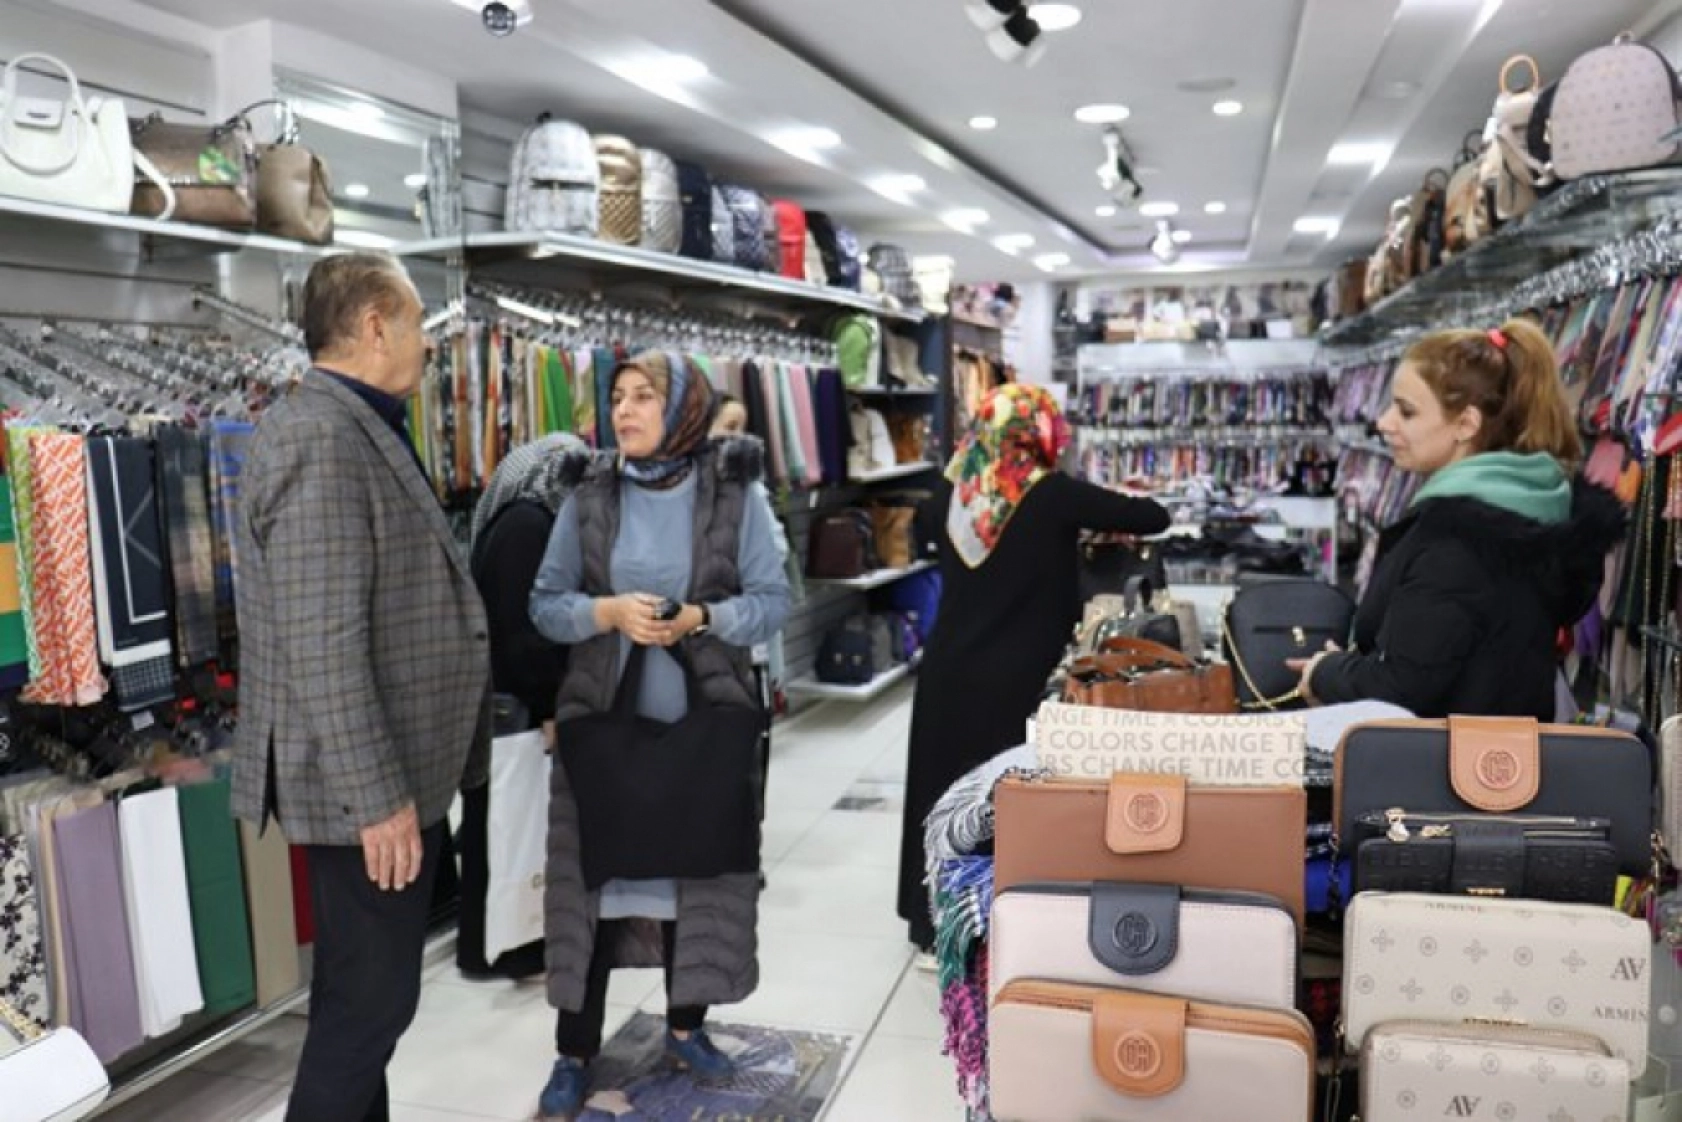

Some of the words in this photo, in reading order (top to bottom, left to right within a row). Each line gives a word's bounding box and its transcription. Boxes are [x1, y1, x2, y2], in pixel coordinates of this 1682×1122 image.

[1101, 710, 1156, 728] TIME
[1049, 730, 1154, 753] COLORS
[1161, 732, 1273, 753] CHANGE
[1081, 755, 1192, 777] CHANGE
[1198, 757, 1265, 779] TIME
[1610, 957, 1647, 981] AV
[1442, 1095, 1482, 1117] AV
